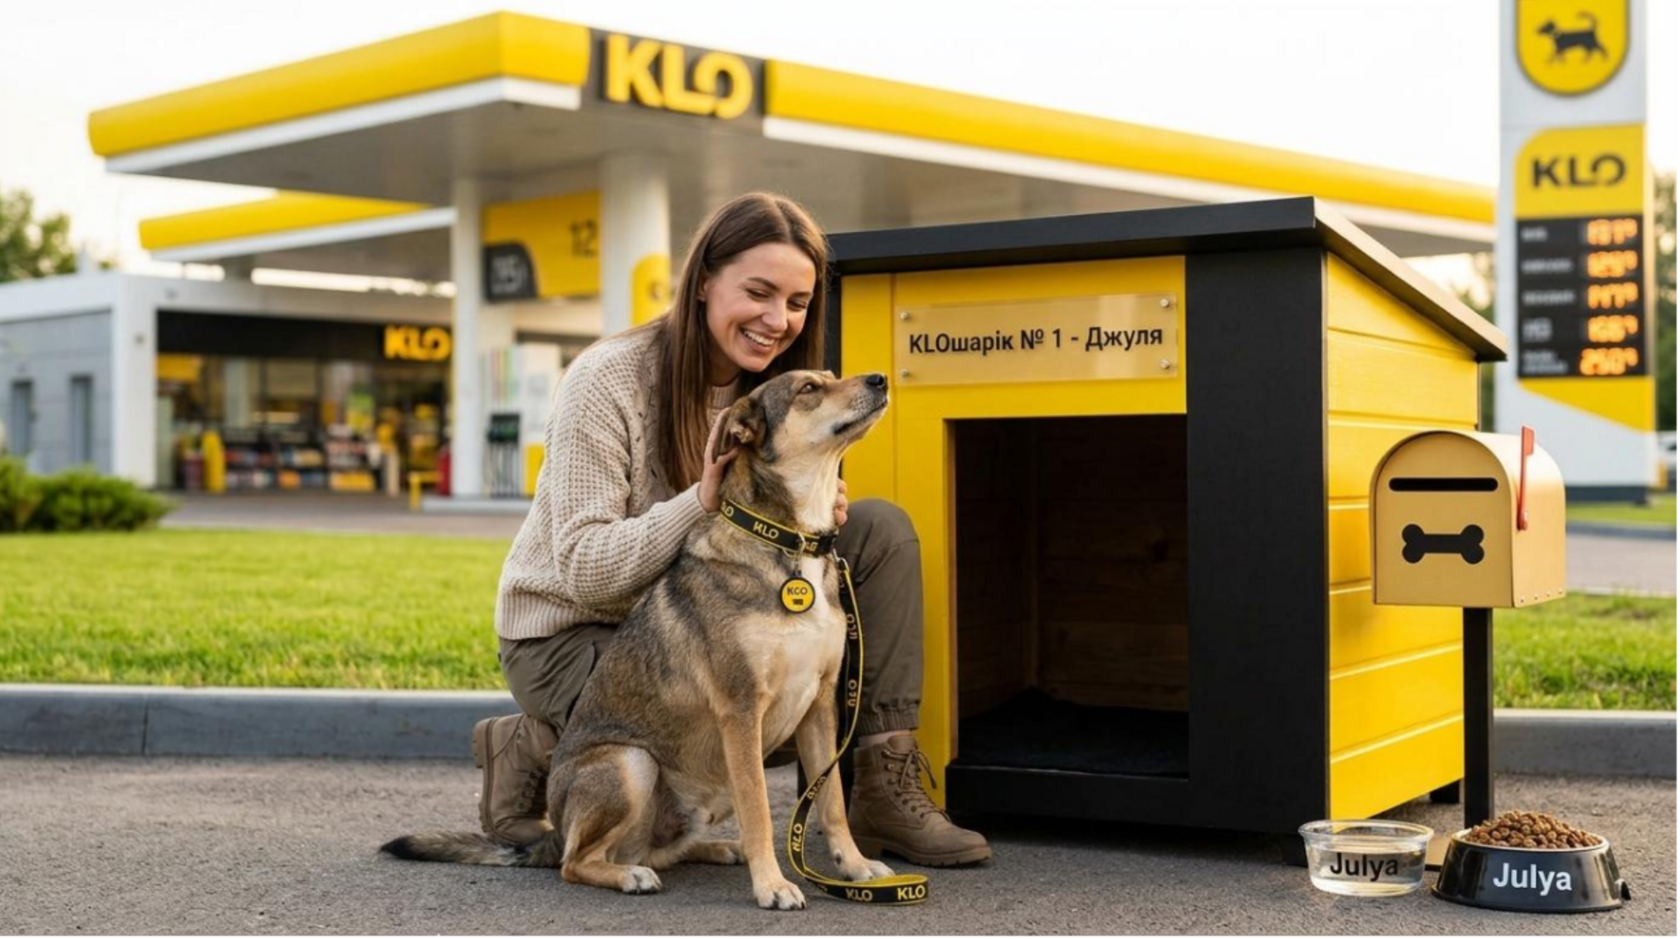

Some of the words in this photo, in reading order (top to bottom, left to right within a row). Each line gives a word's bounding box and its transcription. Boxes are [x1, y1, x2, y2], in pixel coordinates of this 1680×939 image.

[606, 33, 753, 119] KLO
[1531, 154, 1627, 188] KLO
[384, 325, 451, 362] KLO
[909, 330, 1014, 356] KLOшарік
[1020, 328, 1045, 350] №
[1052, 328, 1062, 348] 1
[1085, 326, 1163, 351] Джуля
[752, 520, 779, 539] KLO
[1329, 852, 1400, 881] Julya
[1493, 862, 1573, 896] Julya
[897, 884, 926, 901] KLO
